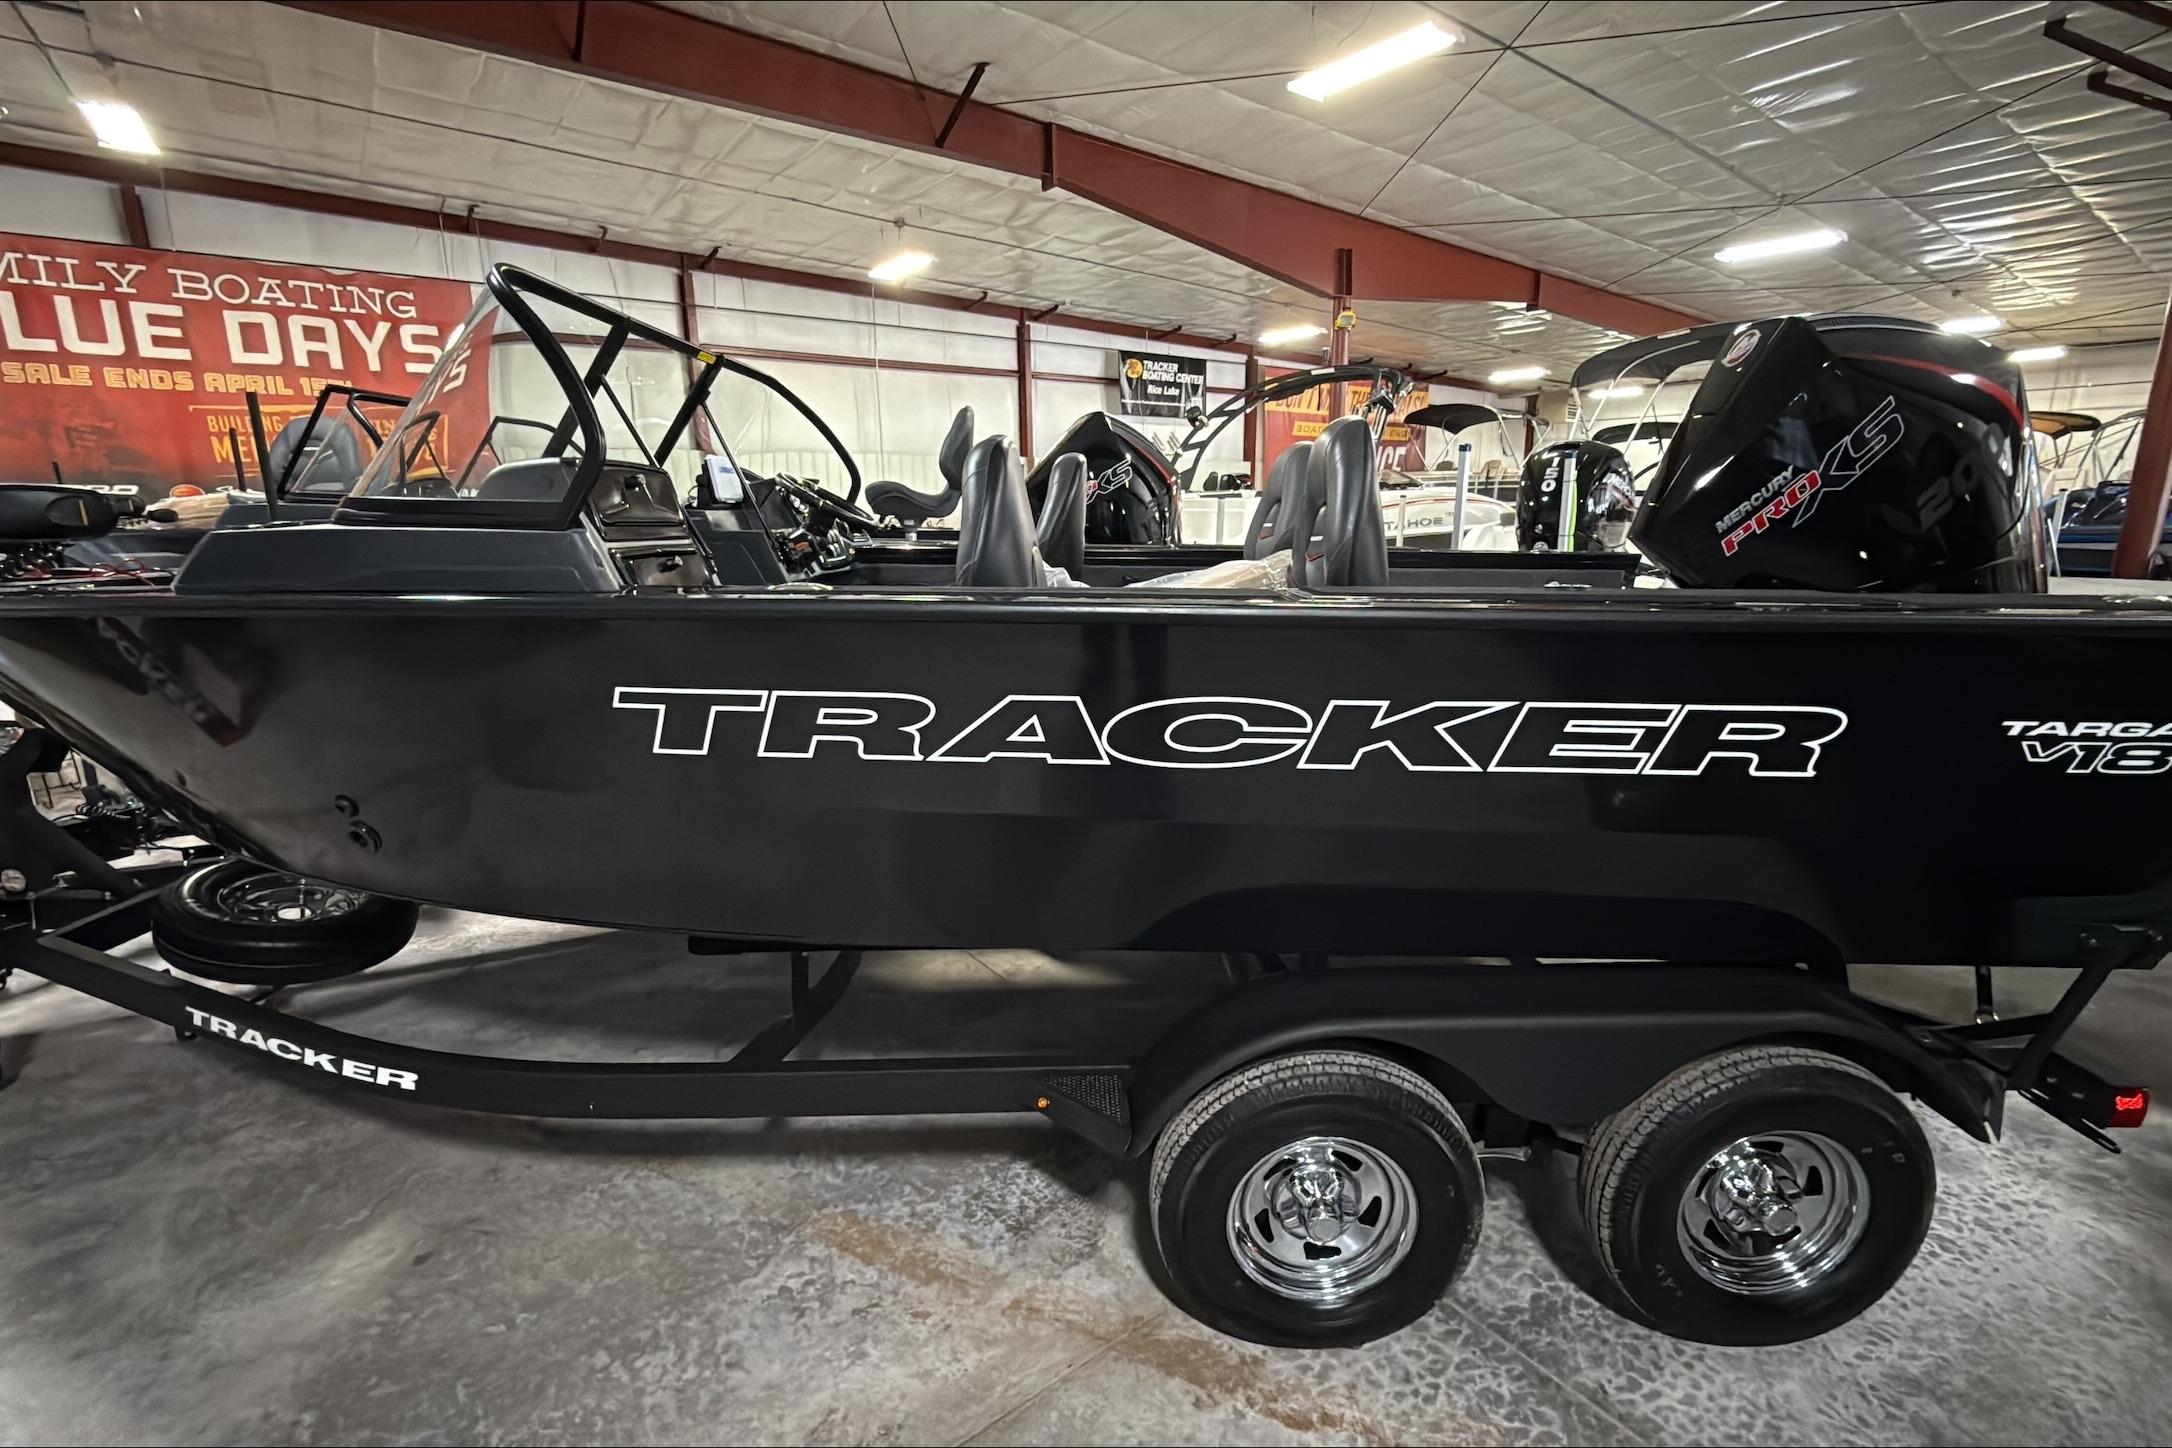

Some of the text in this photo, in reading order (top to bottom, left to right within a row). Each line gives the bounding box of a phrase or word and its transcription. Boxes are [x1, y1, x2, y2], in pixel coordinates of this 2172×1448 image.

[167, 268, 417, 319] BOATING
[0, 290, 444, 374] LUE DAYS
[1, 362, 353, 397] SALE ENDS APRIL 15
[1142, 360, 1179, 373] TRACKER
[1142, 370, 1205, 385] BOATING CENTER
[1147, 384, 1180, 396] Rice Lake
[206, 415, 284, 433] BUILNG
[1714, 464, 1796, 534] MERCURY
[1720, 469, 1823, 558] PRO
[612, 686, 1849, 778] TRACKER
[185, 1005, 419, 1092] TRACKER
